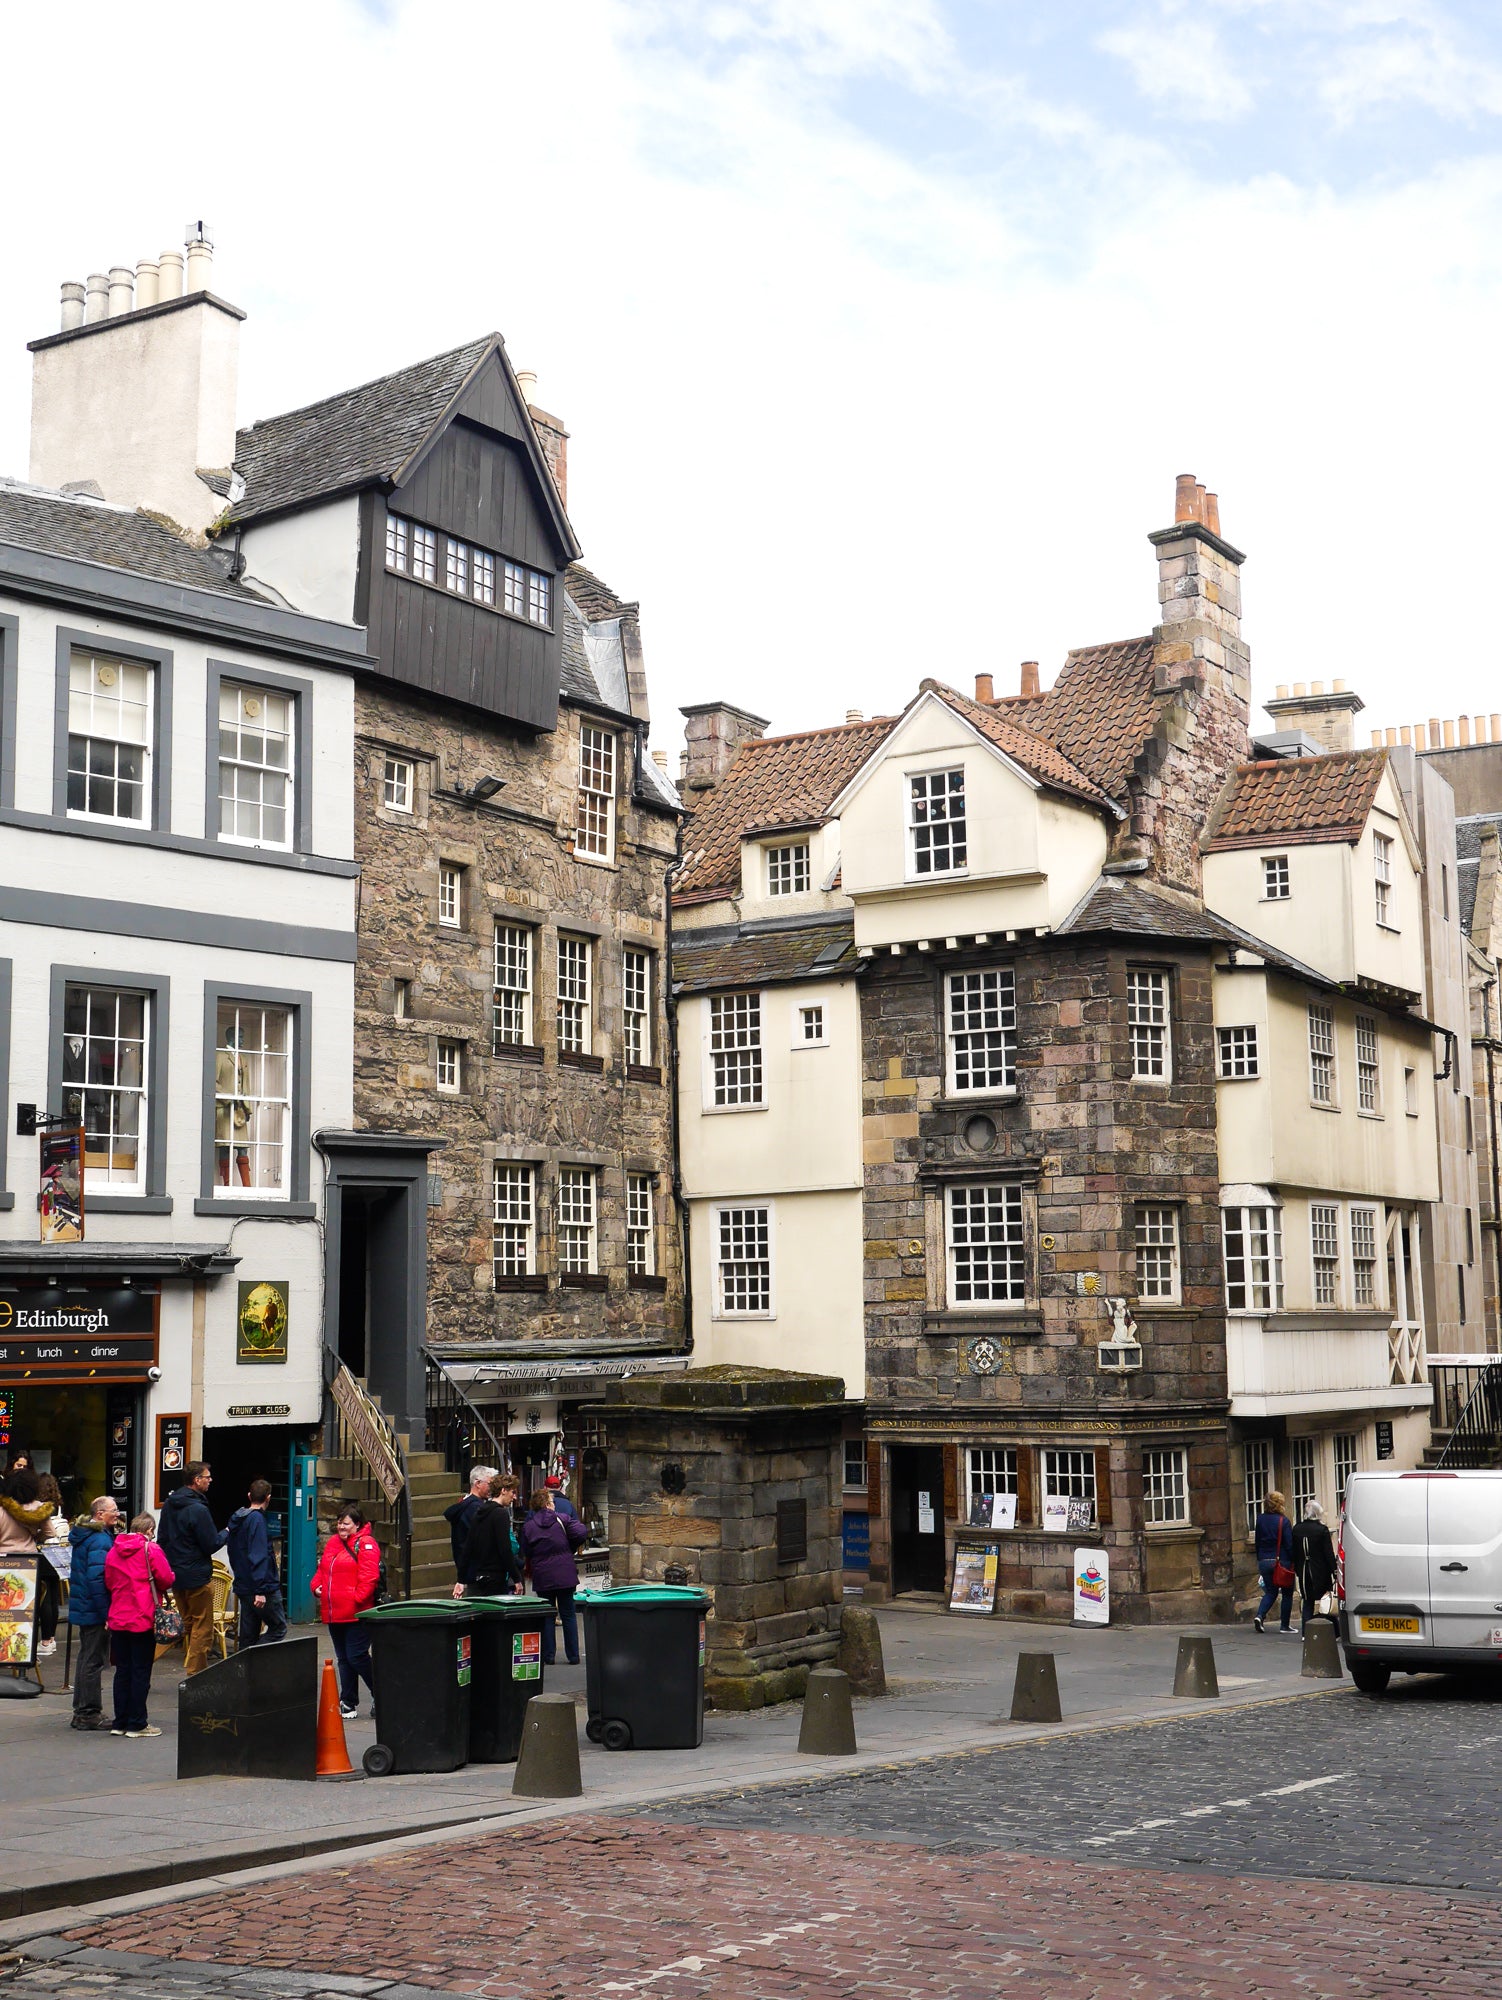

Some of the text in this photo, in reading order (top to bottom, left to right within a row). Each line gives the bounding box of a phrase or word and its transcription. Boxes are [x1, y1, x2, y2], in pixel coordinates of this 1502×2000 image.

[15, 1309, 109, 1332] Edinburgh
[37, 1347, 62, 1358] lunch
[90, 1346, 119, 1357] dinner
[546, 1367, 564, 1377] KILT
[594, 1363, 647, 1374] SPECIALISTS
[265, 1405, 287, 1414] CLOSE
[926, 1420, 946, 1428] GOD
[999, 1420, 1017, 1428] AND
[1160, 1420, 1182, 1428] SELF
[1080, 1580, 1095, 1590] STORY
[1368, 1618, 1412, 1630] SG18 NKC
